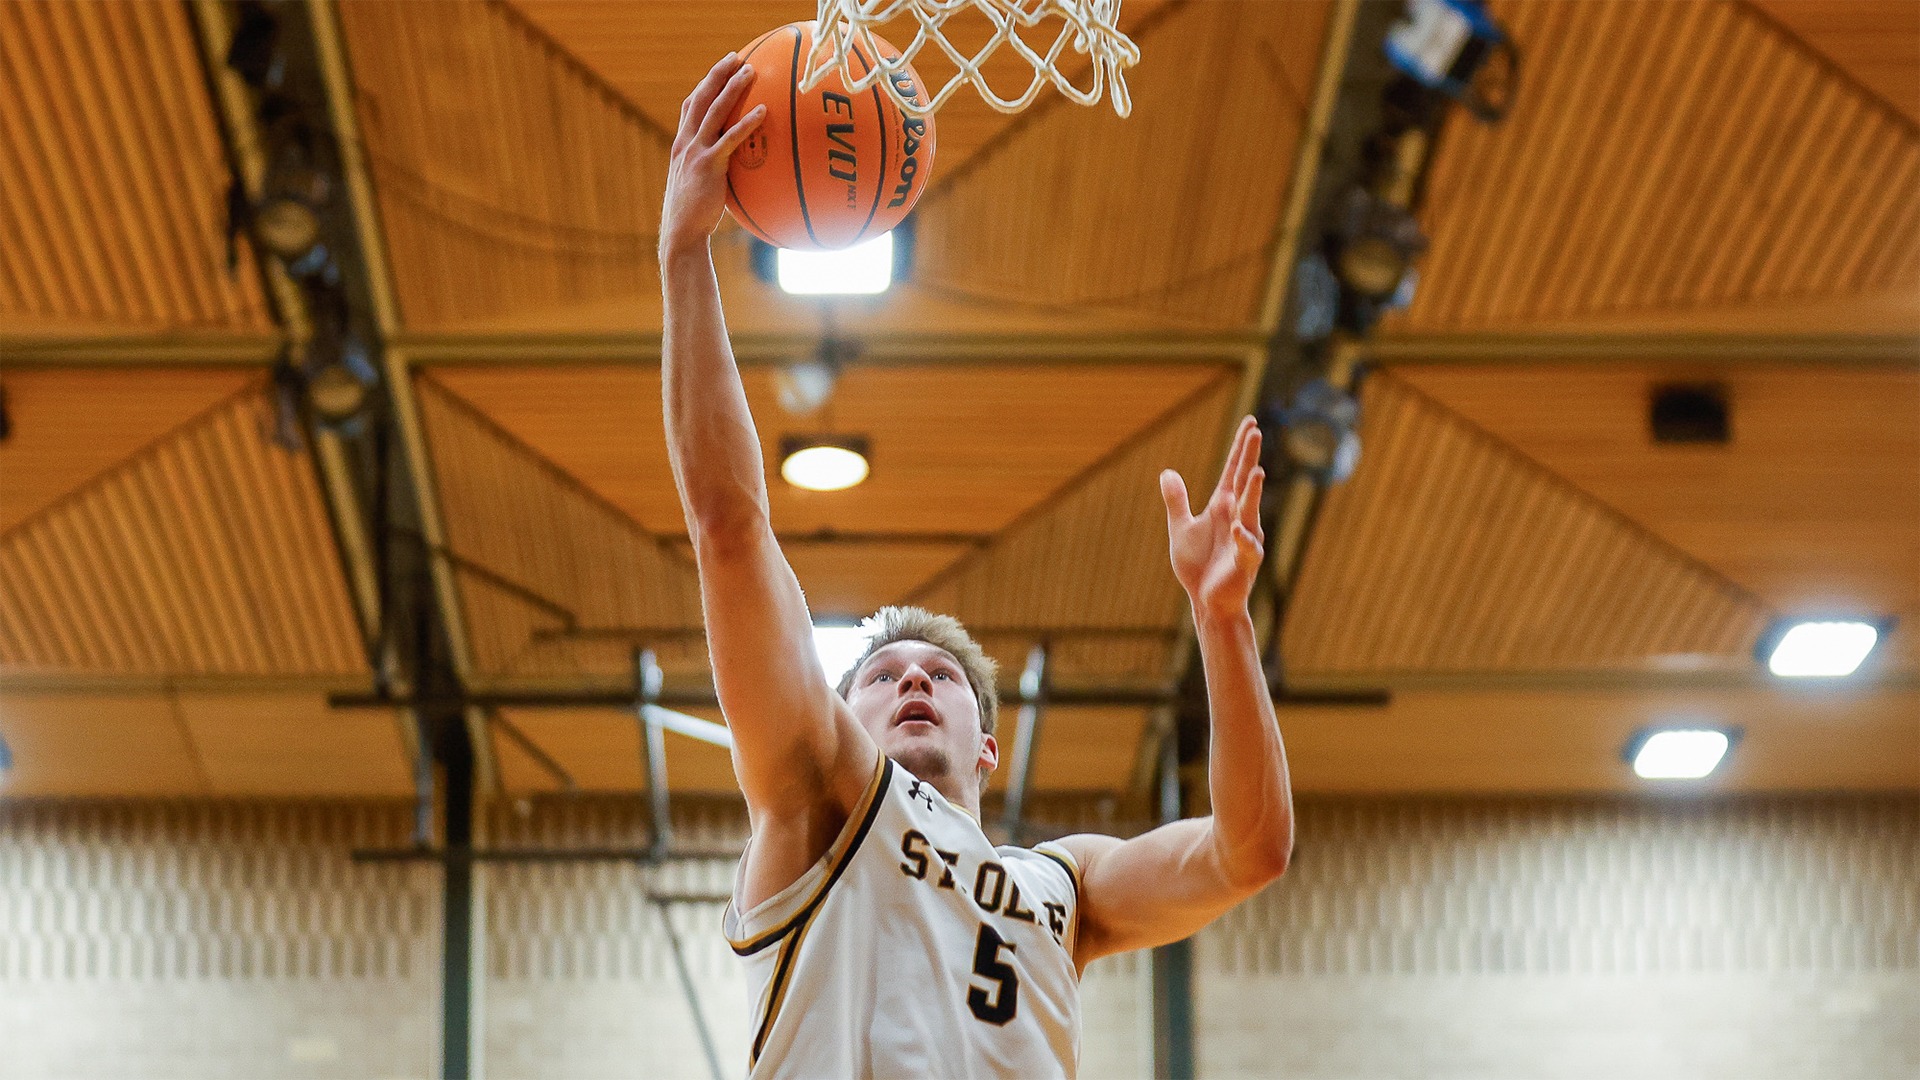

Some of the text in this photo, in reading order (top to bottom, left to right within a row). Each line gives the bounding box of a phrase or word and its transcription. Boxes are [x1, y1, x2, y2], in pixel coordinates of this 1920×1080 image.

[822, 91, 857, 182] EVO
[973, 861, 1067, 946] OLF
[966, 921, 1019, 1027] 5
